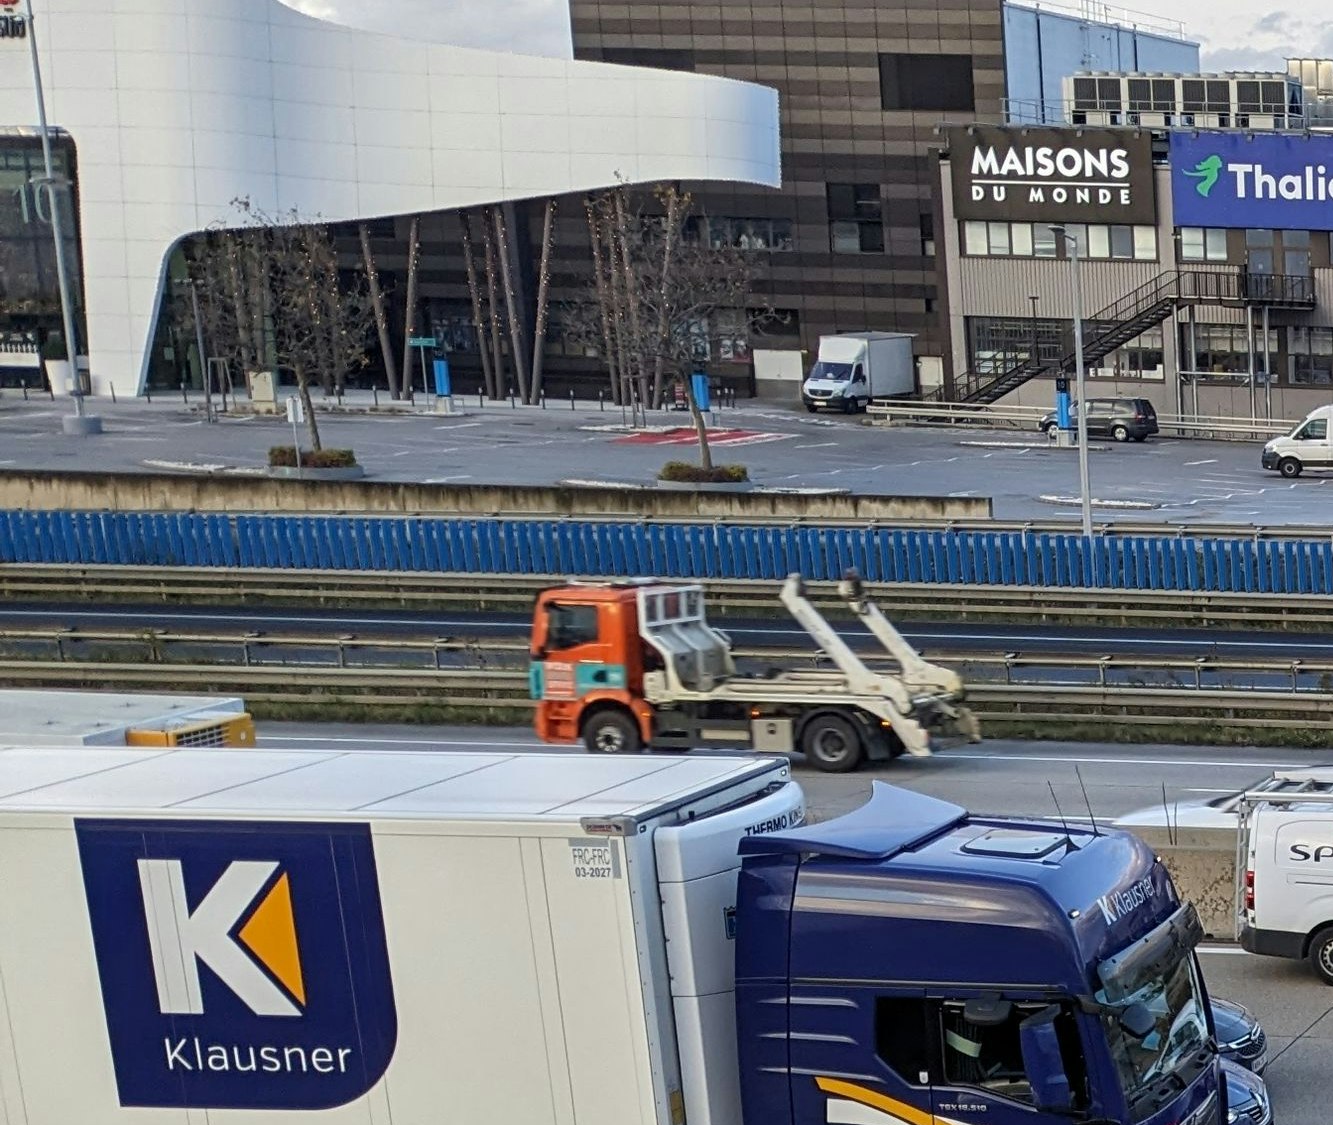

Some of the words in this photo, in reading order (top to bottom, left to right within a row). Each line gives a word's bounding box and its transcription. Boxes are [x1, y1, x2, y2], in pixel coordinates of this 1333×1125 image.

[971, 146, 1130, 178] MAISONS
[971, 185, 1006, 202] DU
[1029, 186, 1131, 205] MONDE
[572, 847, 610, 866] FRC-FRC
[575, 867, 611, 878] 03-2027
[1112, 876, 1156, 918] Klausner
[164, 1038, 351, 1073] Klausner
